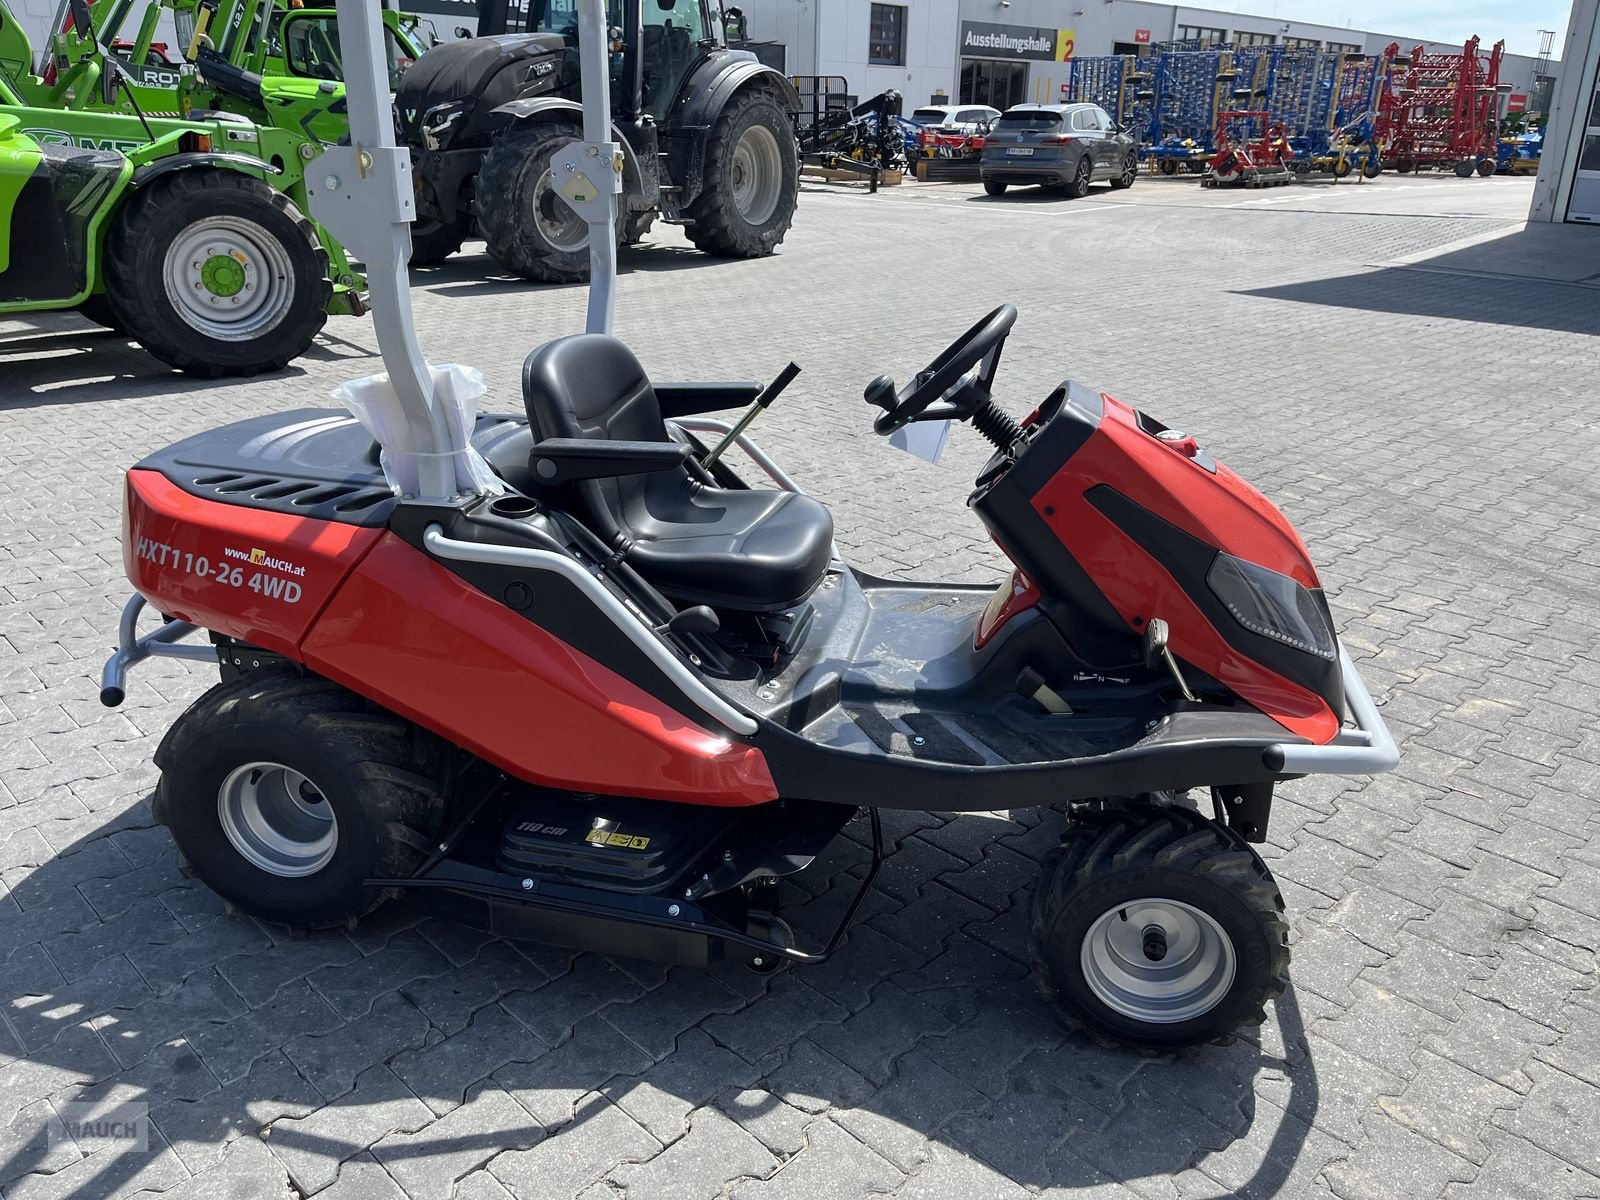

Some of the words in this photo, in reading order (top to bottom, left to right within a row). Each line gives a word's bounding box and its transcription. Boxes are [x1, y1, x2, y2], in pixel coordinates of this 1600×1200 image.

[965, 30, 1051, 53] Ausstellungshalle
[1065, 40, 1074, 62] 2
[136, 536, 243, 588] HXT110-26
[248, 572, 303, 604] 4WD
[224, 547, 306, 577] www.MAUCH.at
[517, 822, 544, 831] 110
[541, 826, 568, 835] cm
